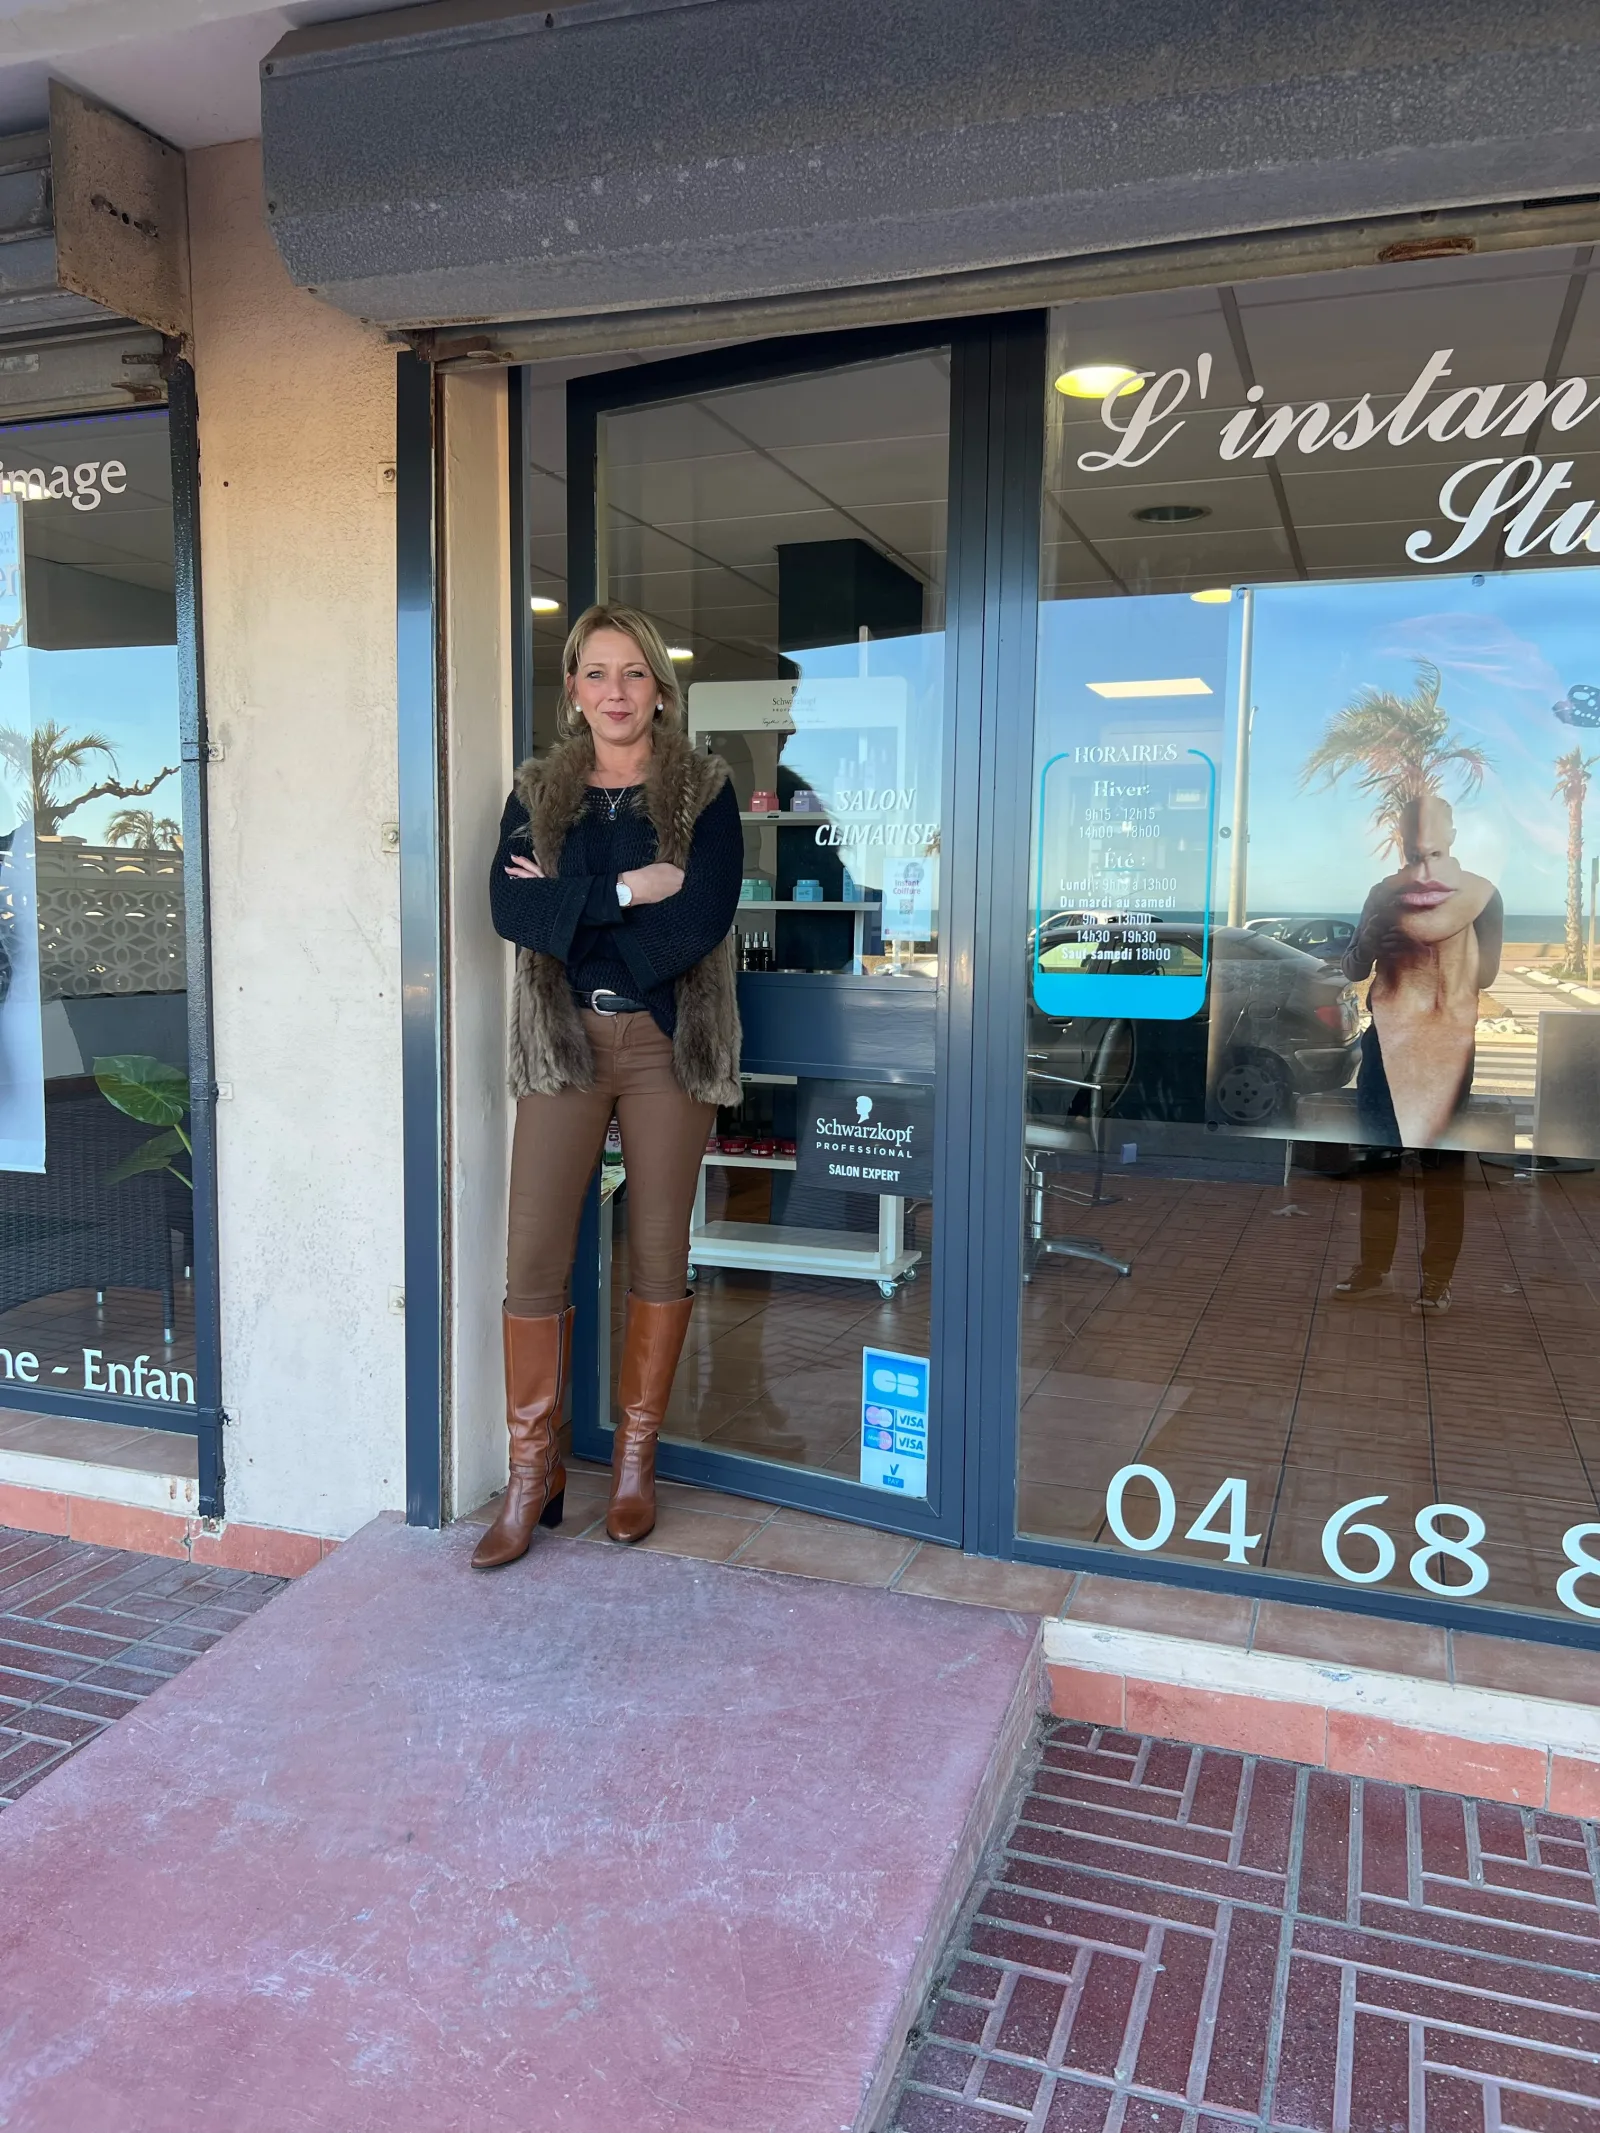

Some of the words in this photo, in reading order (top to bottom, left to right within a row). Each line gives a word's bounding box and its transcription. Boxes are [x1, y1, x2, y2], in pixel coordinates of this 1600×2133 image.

[1074, 744, 1178, 763] HORAIRES
[837, 788, 916, 811] SALON
[1085, 808, 1111, 821] 9h15
[1124, 807, 1156, 820] 12h15
[815, 824, 938, 846] CLIMATISE
[1080, 825, 1113, 839] 14h00
[895, 879, 920, 887] Instant
[1060, 879, 1090, 891] Lundi
[1143, 878, 1177, 891] 13h00
[893, 887, 921, 895] Coiffure
[1060, 896, 1075, 908] Du
[1079, 896, 1112, 908] mardi
[1116, 898, 1130, 908] au
[1134, 896, 1176, 908] samedi
[1117, 913, 1152, 926] 13h00
[1076, 931, 1110, 943] 14h30
[1122, 931, 1157, 943] 19h30
[1062, 948, 1087, 960] Sauf
[1091, 947, 1133, 960] samedi
[1136, 948, 1171, 960] 18h00
[816, 1118, 914, 1147] Schwarzkopf
[816, 1141, 913, 1158] PROFESSIONAL
[829, 1163, 860, 1178] SALON
[862, 1167, 900, 1182] EXPERT
[899, 1415, 924, 1429] VISA
[899, 1437, 924, 1451] VISA
[889, 1463, 900, 1476] V
[887, 1477, 900, 1487] PAY
[1105, 1463, 1262, 1565] 04
[1321, 1495, 1490, 1597] 68
